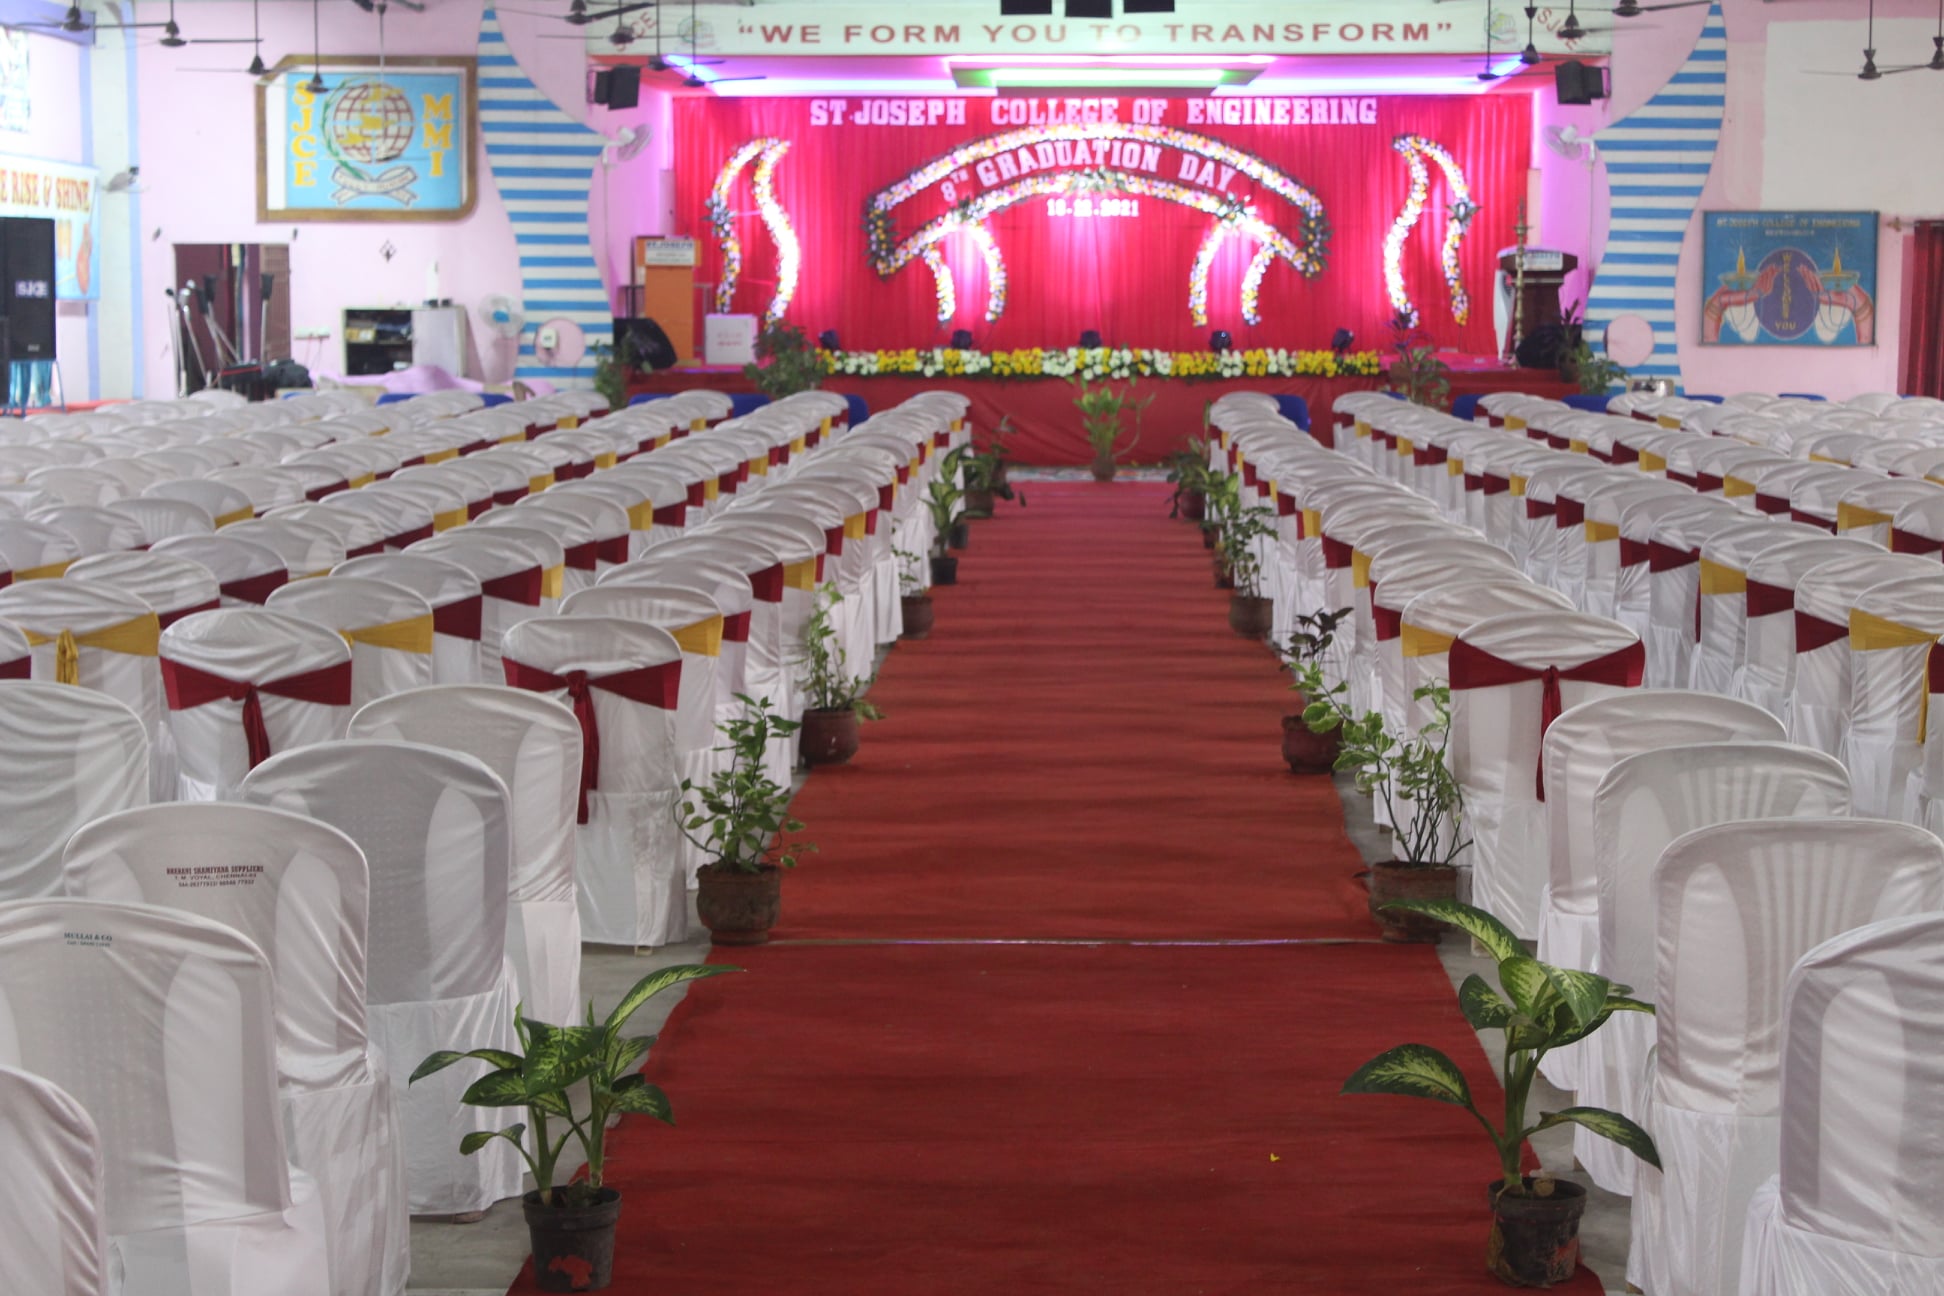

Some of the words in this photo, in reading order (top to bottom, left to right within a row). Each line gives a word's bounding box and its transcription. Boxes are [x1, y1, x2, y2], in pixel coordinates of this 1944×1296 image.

[844, 25, 961, 43] FORM
[982, 24, 1067, 43] YOU
[1088, 24, 1142, 43] TO
[990, 98, 1119, 127] COLLEGE
[1132, 98, 1168, 126] OF
[1187, 98, 1378, 126] ENGINEERING
[975, 139, 1162, 188] GRADUATION
[1178, 152, 1238, 192] DAY
[12, 171, 39, 207] RISE
[56, 176, 90, 213] SHINE
